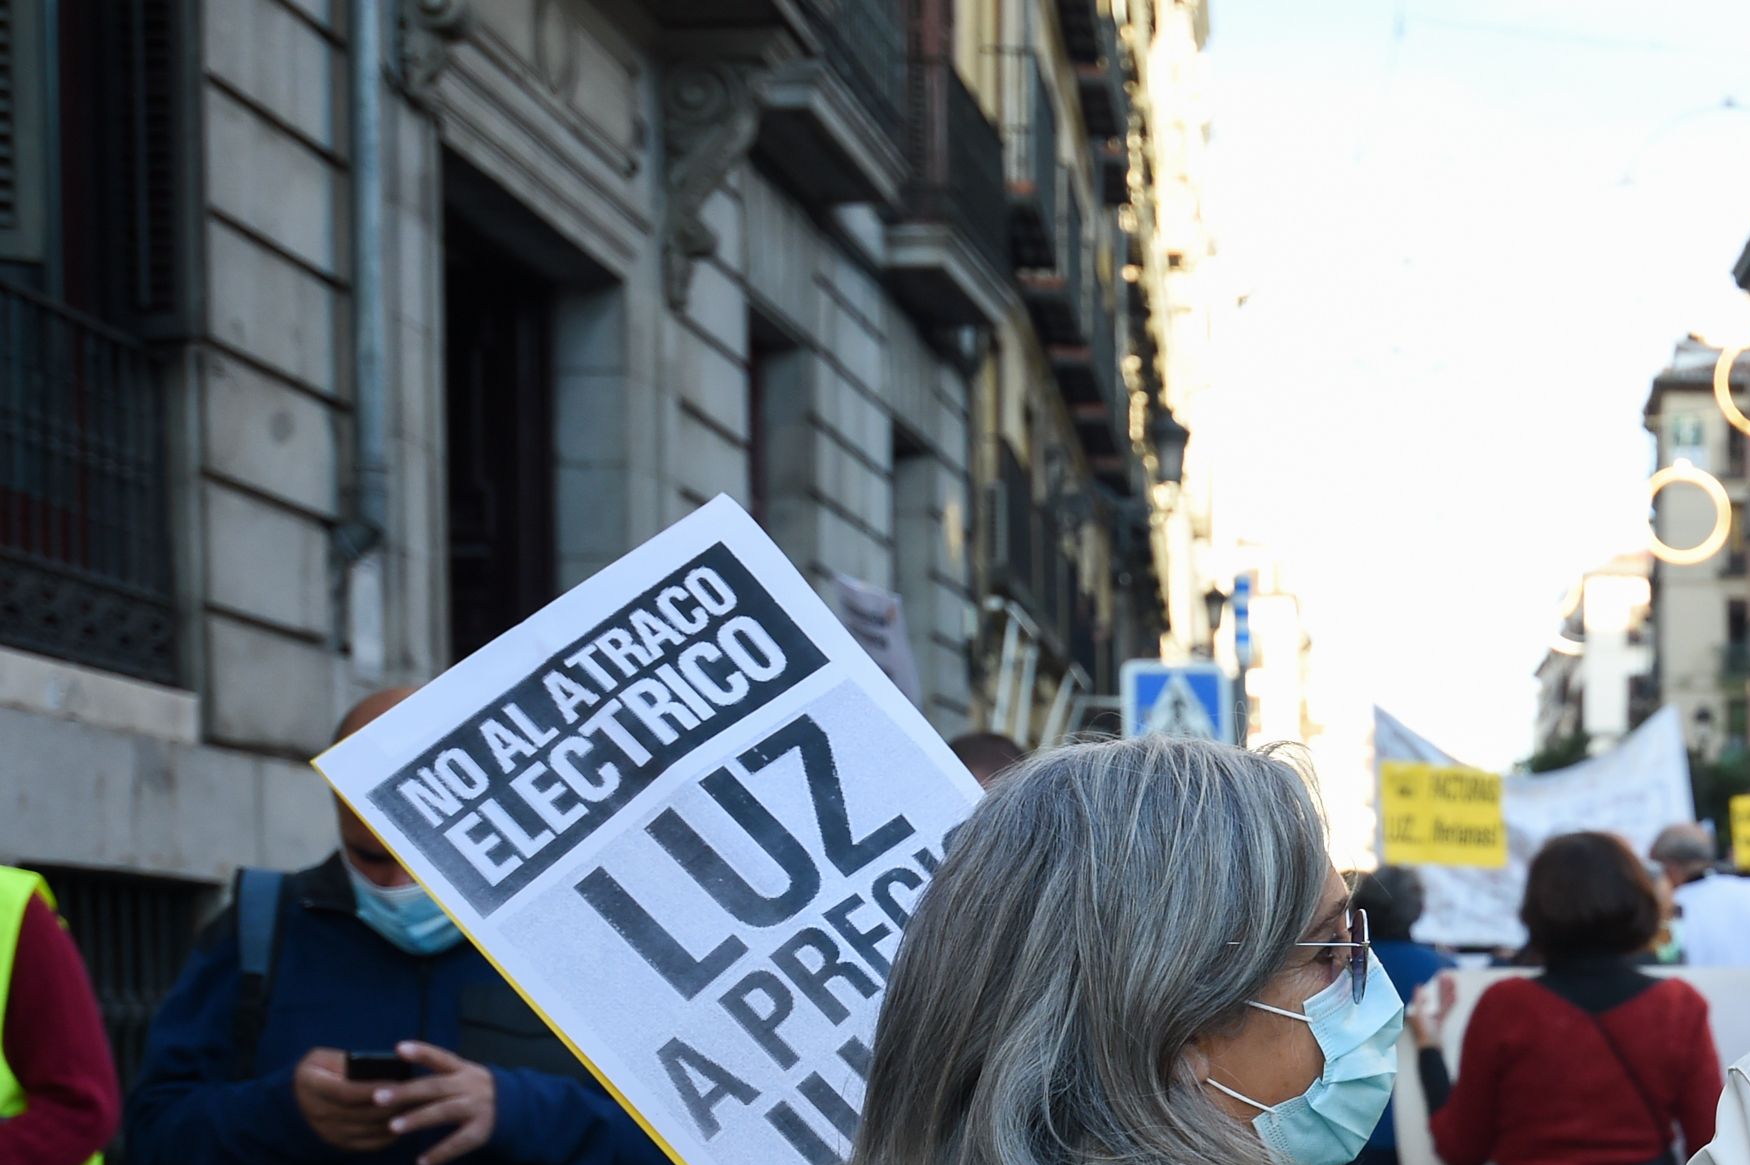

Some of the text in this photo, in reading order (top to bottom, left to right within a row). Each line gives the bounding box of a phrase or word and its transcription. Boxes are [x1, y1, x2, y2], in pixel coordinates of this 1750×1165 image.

[398, 745, 490, 829] NO
[479, 702, 560, 775] AL
[541, 565, 738, 726] ATRACO
[443, 615, 788, 888] ELECTRICO
[575, 712, 918, 1001] LUZ
[656, 1036, 763, 1143] A
[717, 826, 966, 1072] PREC
